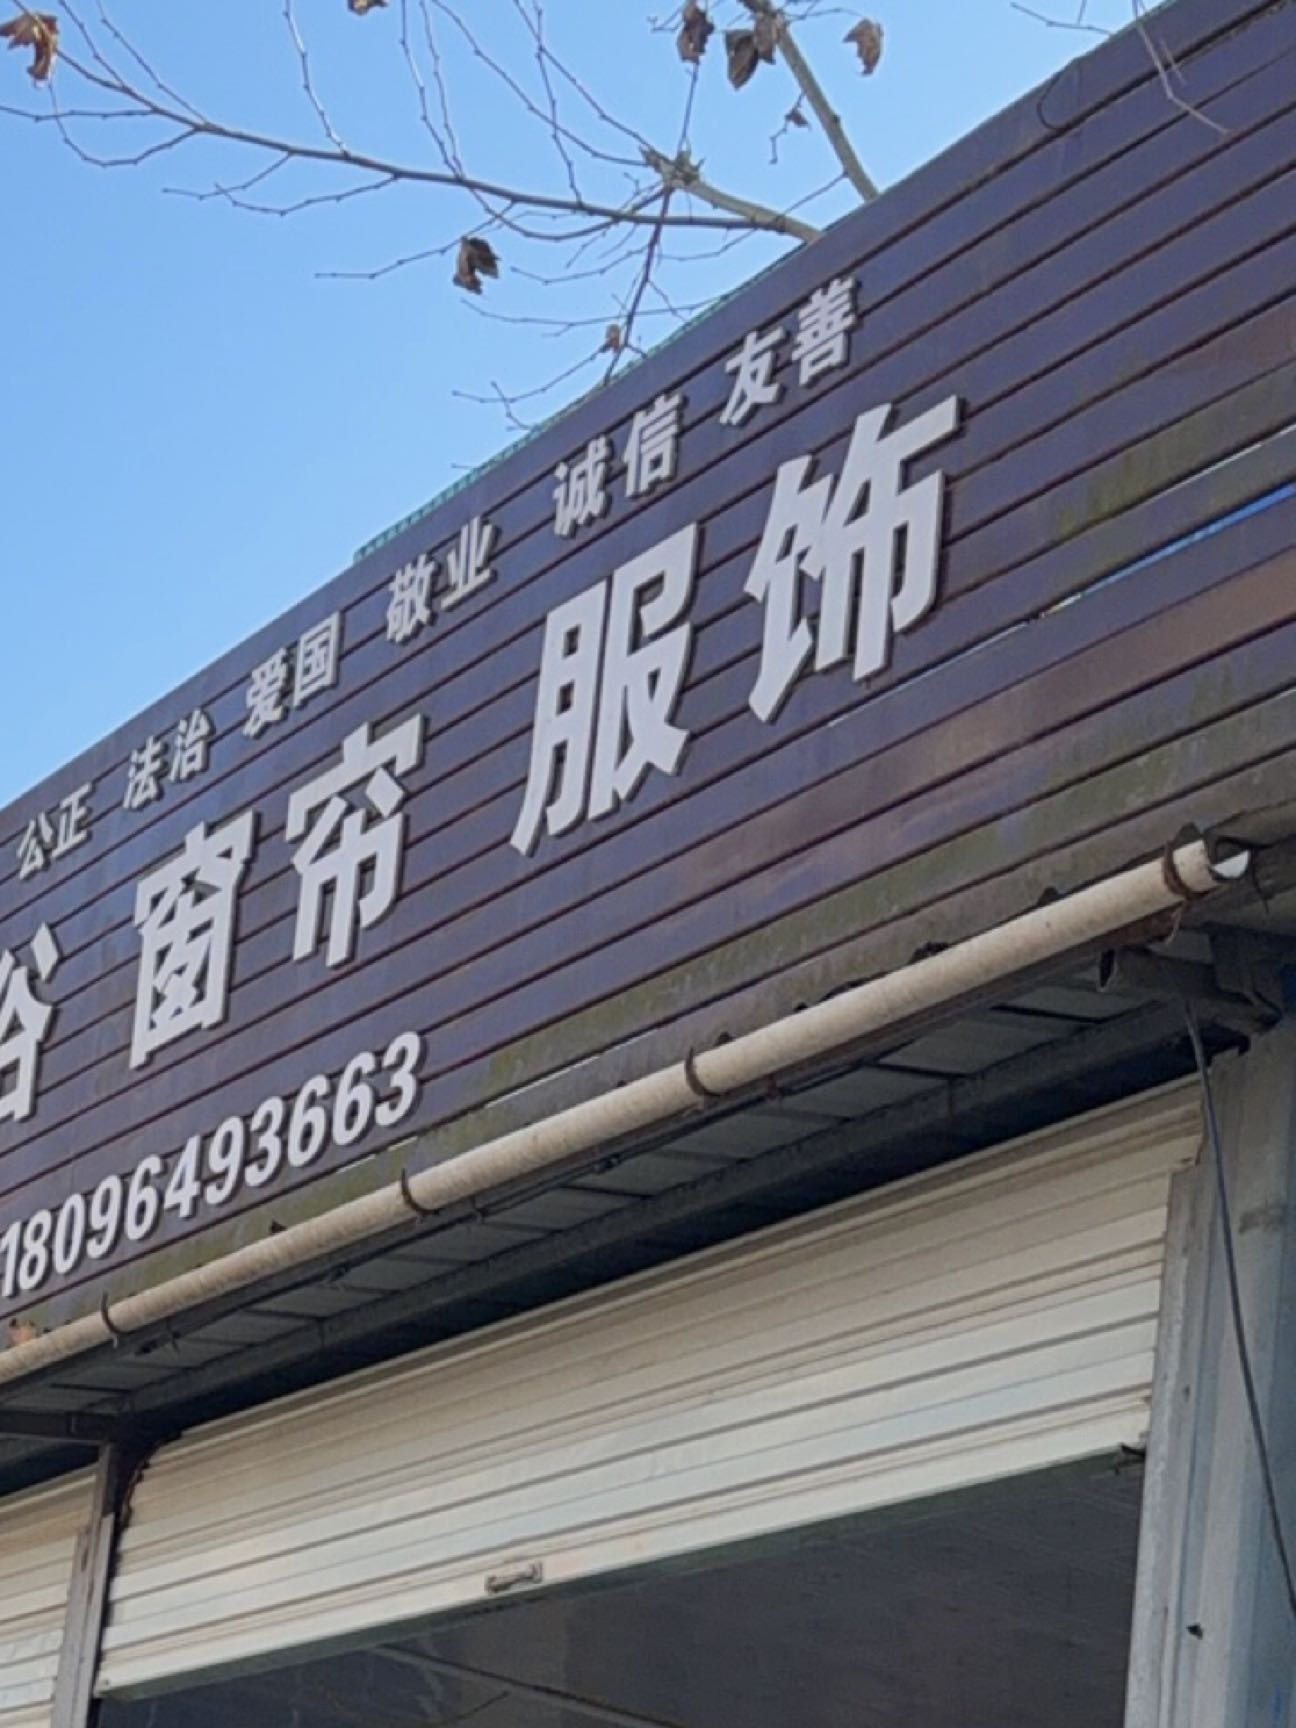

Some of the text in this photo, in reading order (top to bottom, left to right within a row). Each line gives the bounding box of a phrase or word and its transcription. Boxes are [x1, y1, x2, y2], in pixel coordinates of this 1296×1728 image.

[18, 784, 92, 879] 公正
[124, 710, 213, 808] 法治
[242, 612, 340, 736] 爱国
[387, 517, 498, 641] 敬业
[553, 393, 685, 536] 诚信
[720, 277, 859, 424] 友善
[130, 714, 425, 1068] 窗帘
[511, 395, 960, 855] 服饰
[0, 1033, 422, 1297] 18096493663
